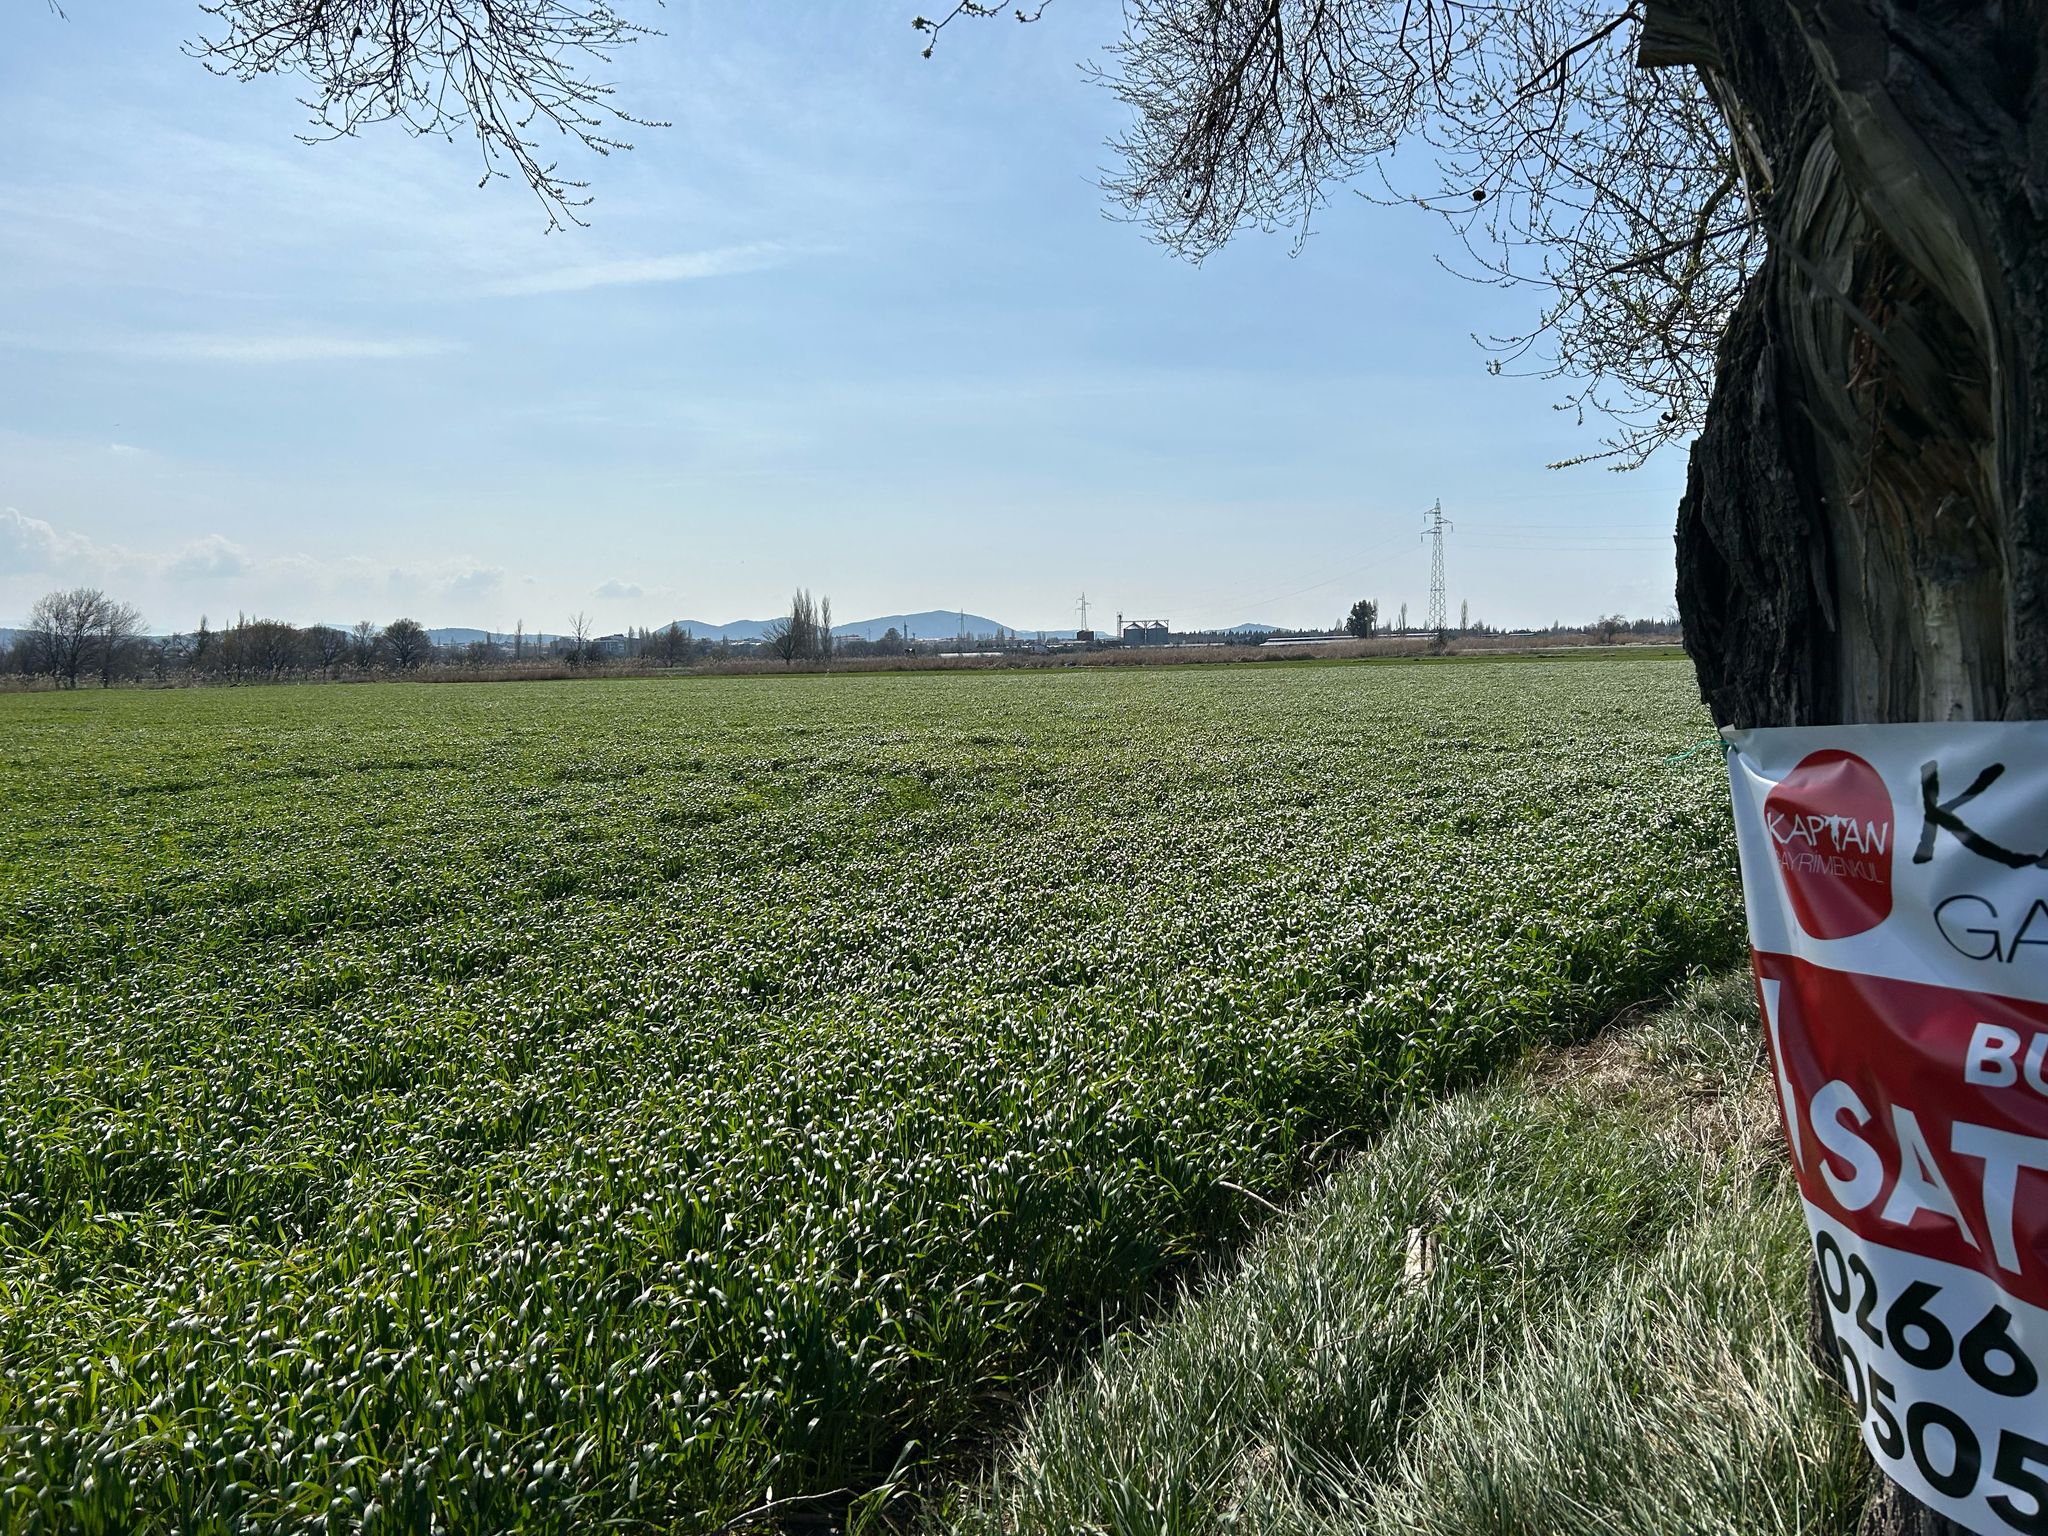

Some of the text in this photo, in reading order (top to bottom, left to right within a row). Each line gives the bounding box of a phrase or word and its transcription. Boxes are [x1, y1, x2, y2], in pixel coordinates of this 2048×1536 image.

[1767, 811, 1888, 856] KAPTAN
[1912, 759, 2048, 869] K
[1810, 1080, 2048, 1276] SAT
[1816, 1230, 2039, 1398] 0266
